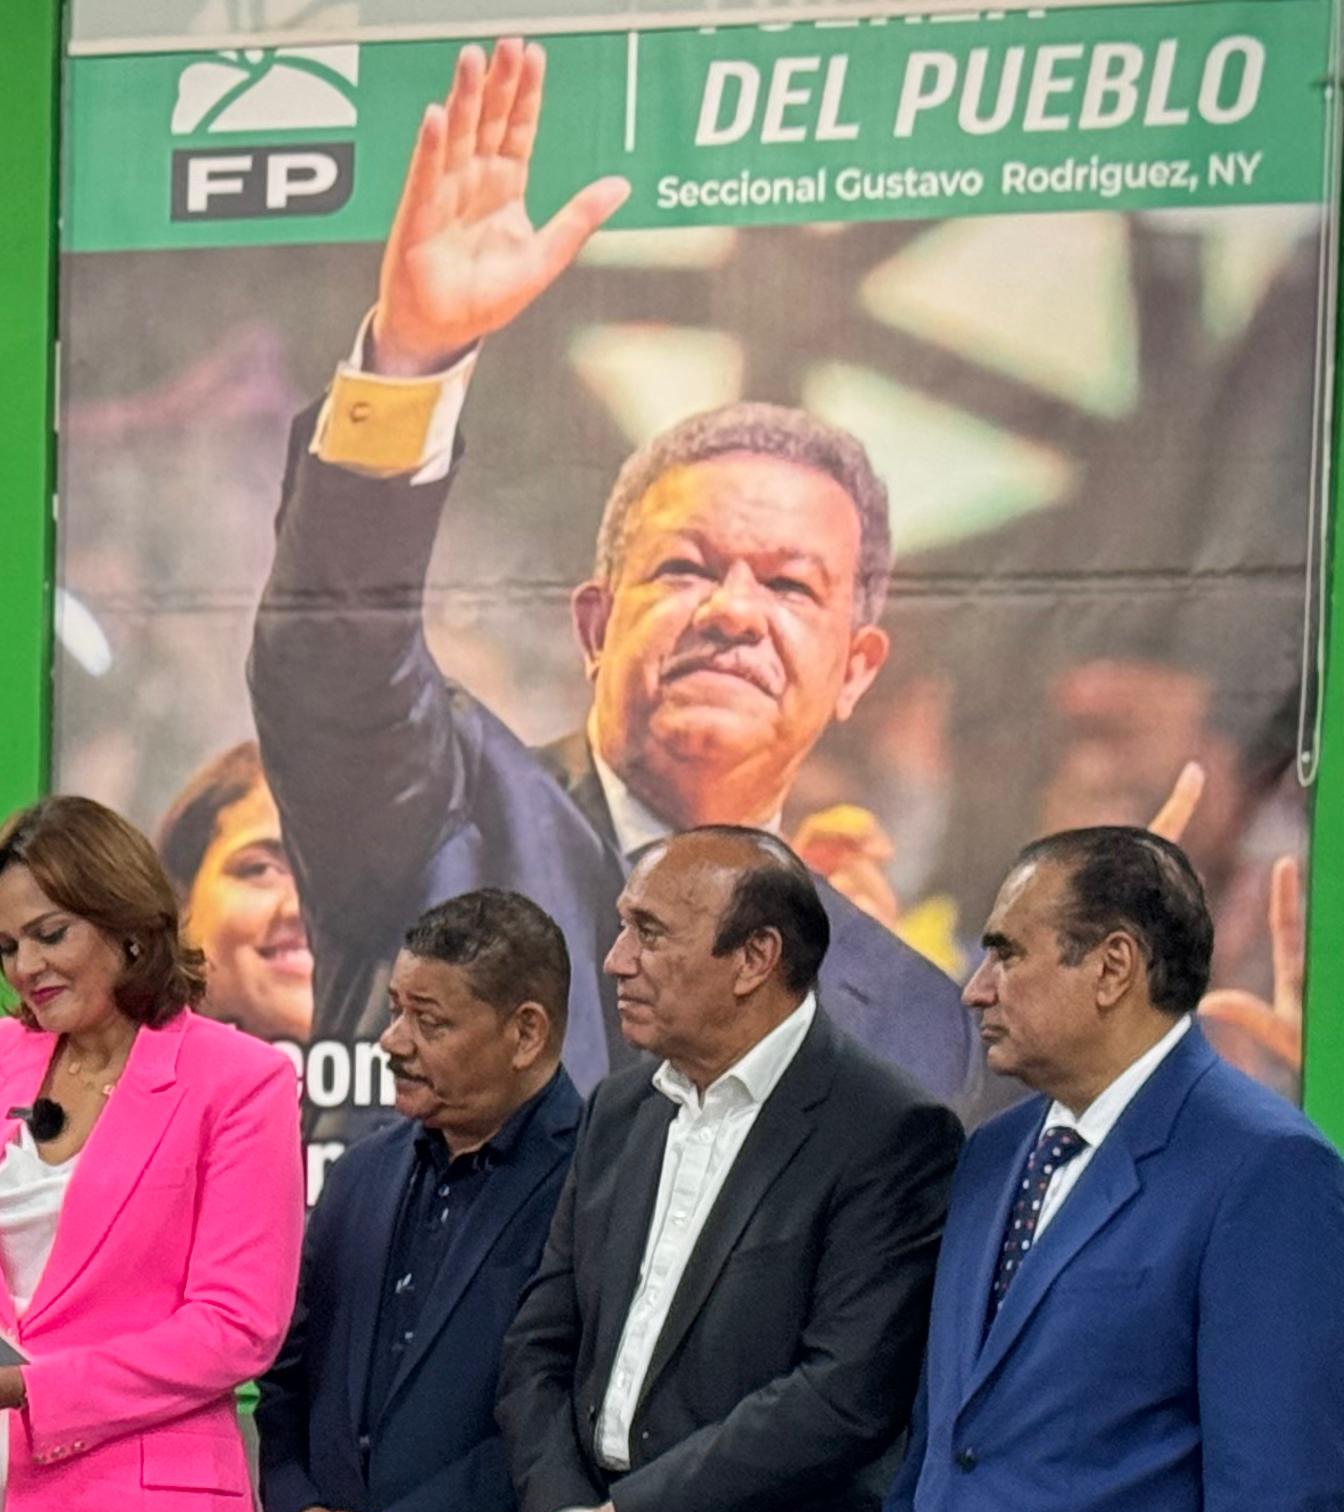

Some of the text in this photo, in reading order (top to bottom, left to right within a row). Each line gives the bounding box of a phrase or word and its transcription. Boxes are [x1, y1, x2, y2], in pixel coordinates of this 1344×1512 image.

[694, 34, 1266, 147] DEL PUEBLO
[187, 152, 338, 213] FP
[657, 168, 826, 209] Seccional
[835, 168, 984, 201] Gustavo
[1208, 151, 1262, 187] NY
